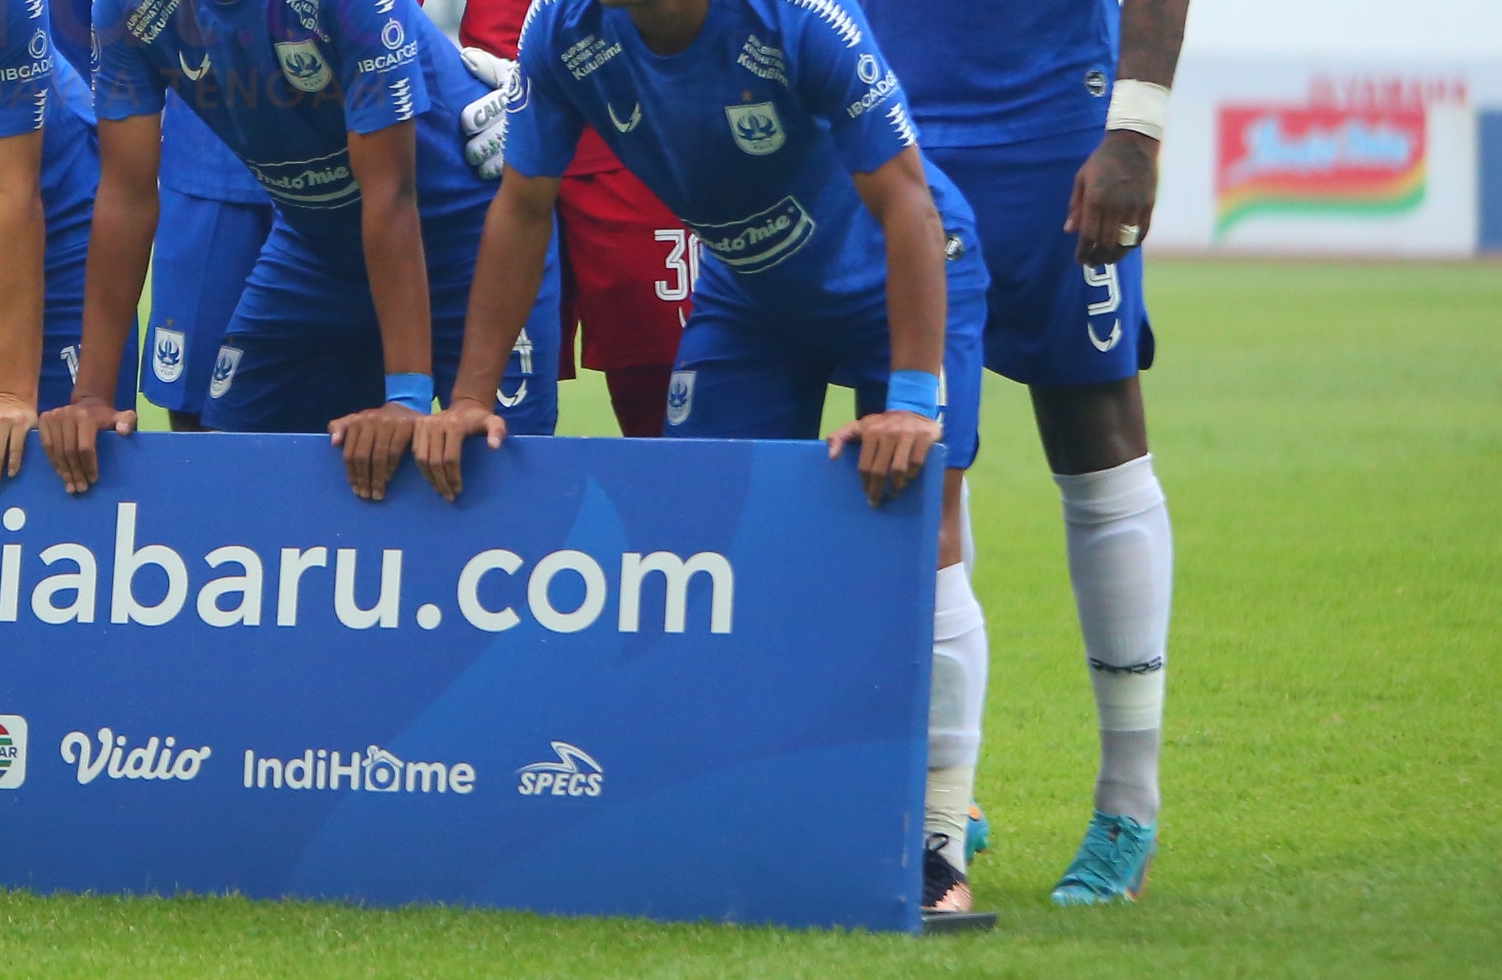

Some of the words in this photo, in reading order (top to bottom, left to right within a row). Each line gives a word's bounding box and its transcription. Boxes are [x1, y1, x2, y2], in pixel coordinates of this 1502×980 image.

[60, 727, 212, 784] Vidio
[243, 745, 476, 795] IndiHome
[518, 771, 604, 797] SPECS
